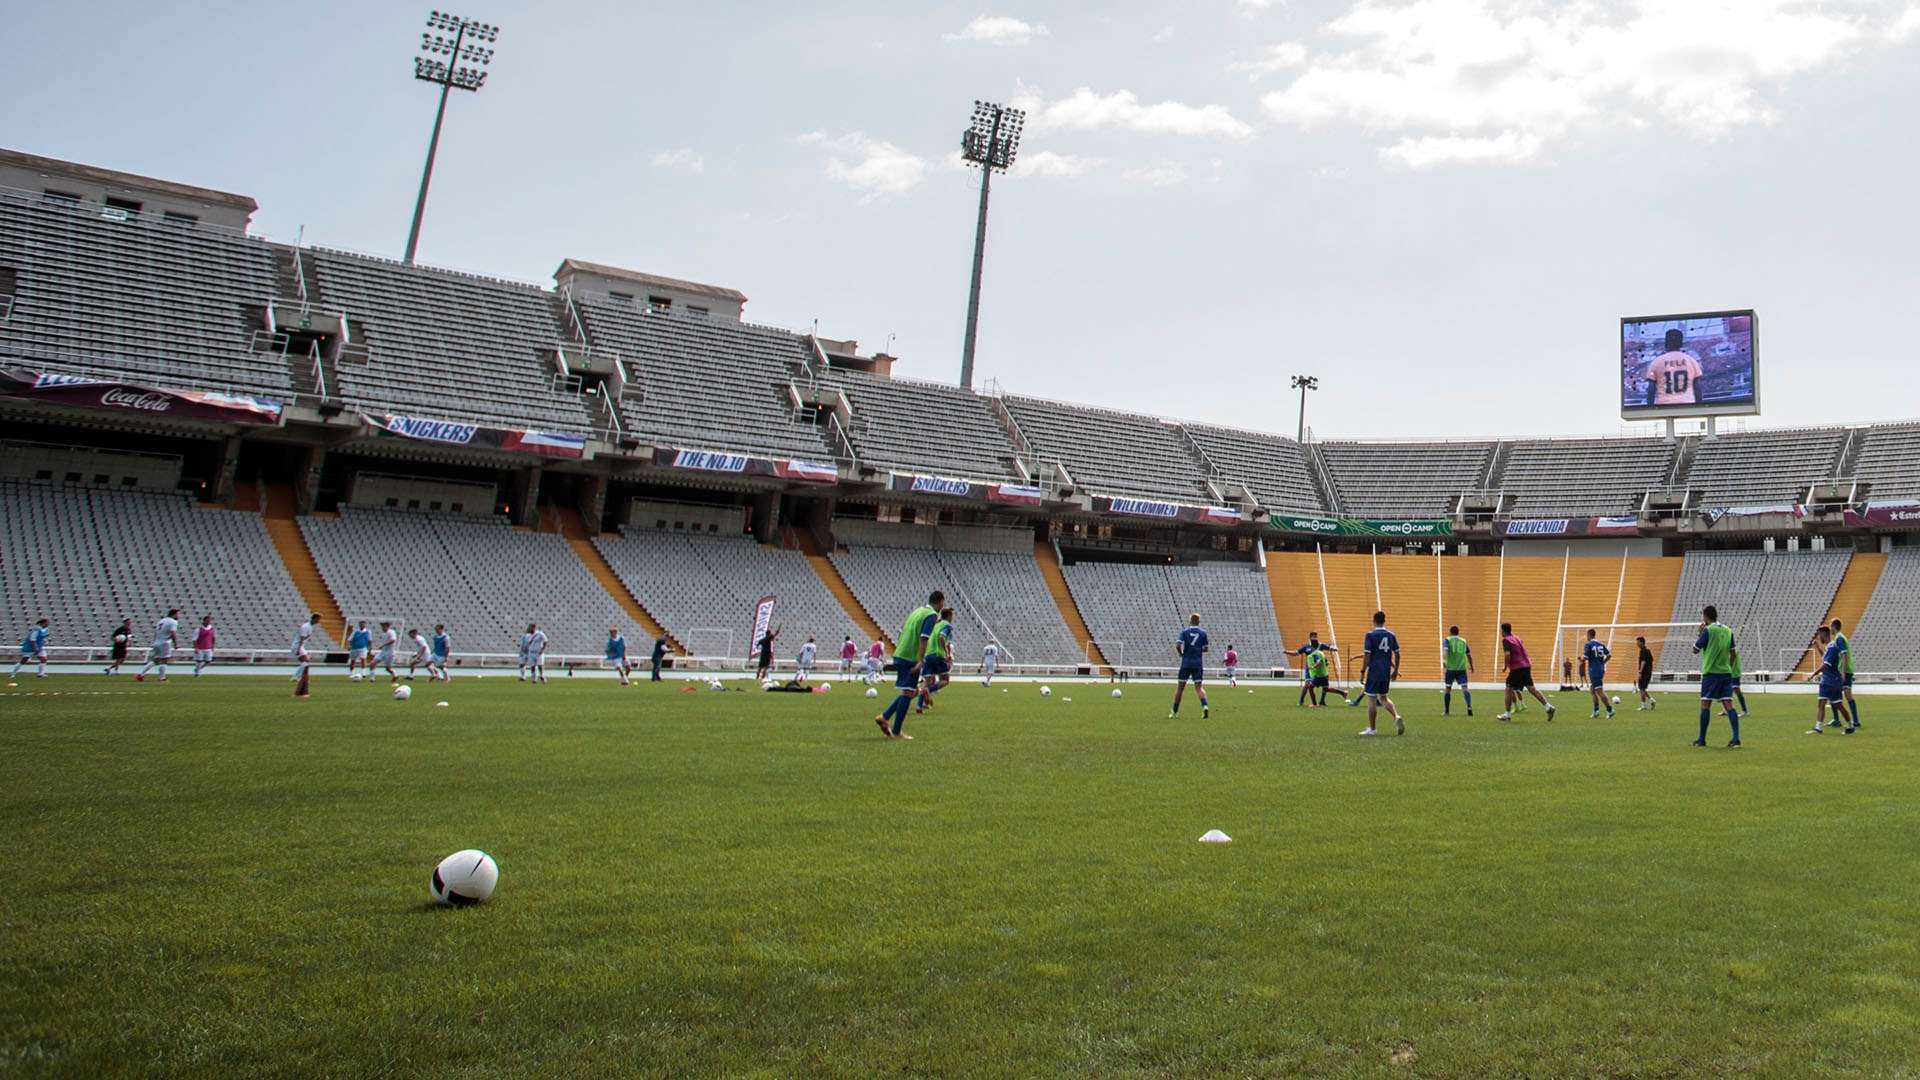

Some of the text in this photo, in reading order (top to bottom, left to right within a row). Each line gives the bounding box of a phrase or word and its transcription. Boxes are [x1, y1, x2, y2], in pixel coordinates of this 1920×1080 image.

[1664, 370, 1688, 394] 10
[390, 417, 475, 443] SNICKERS
[680, 451, 707, 467] THE
[915, 477, 968, 494] SNICKERS
[1112, 498, 1177, 516] WILLKOMMEN
[1294, 520, 1311, 528] OPEN
[1190, 633, 1200, 646] 7
[1378, 637, 1390, 653] 4
[1592, 646, 1605, 657] 15
